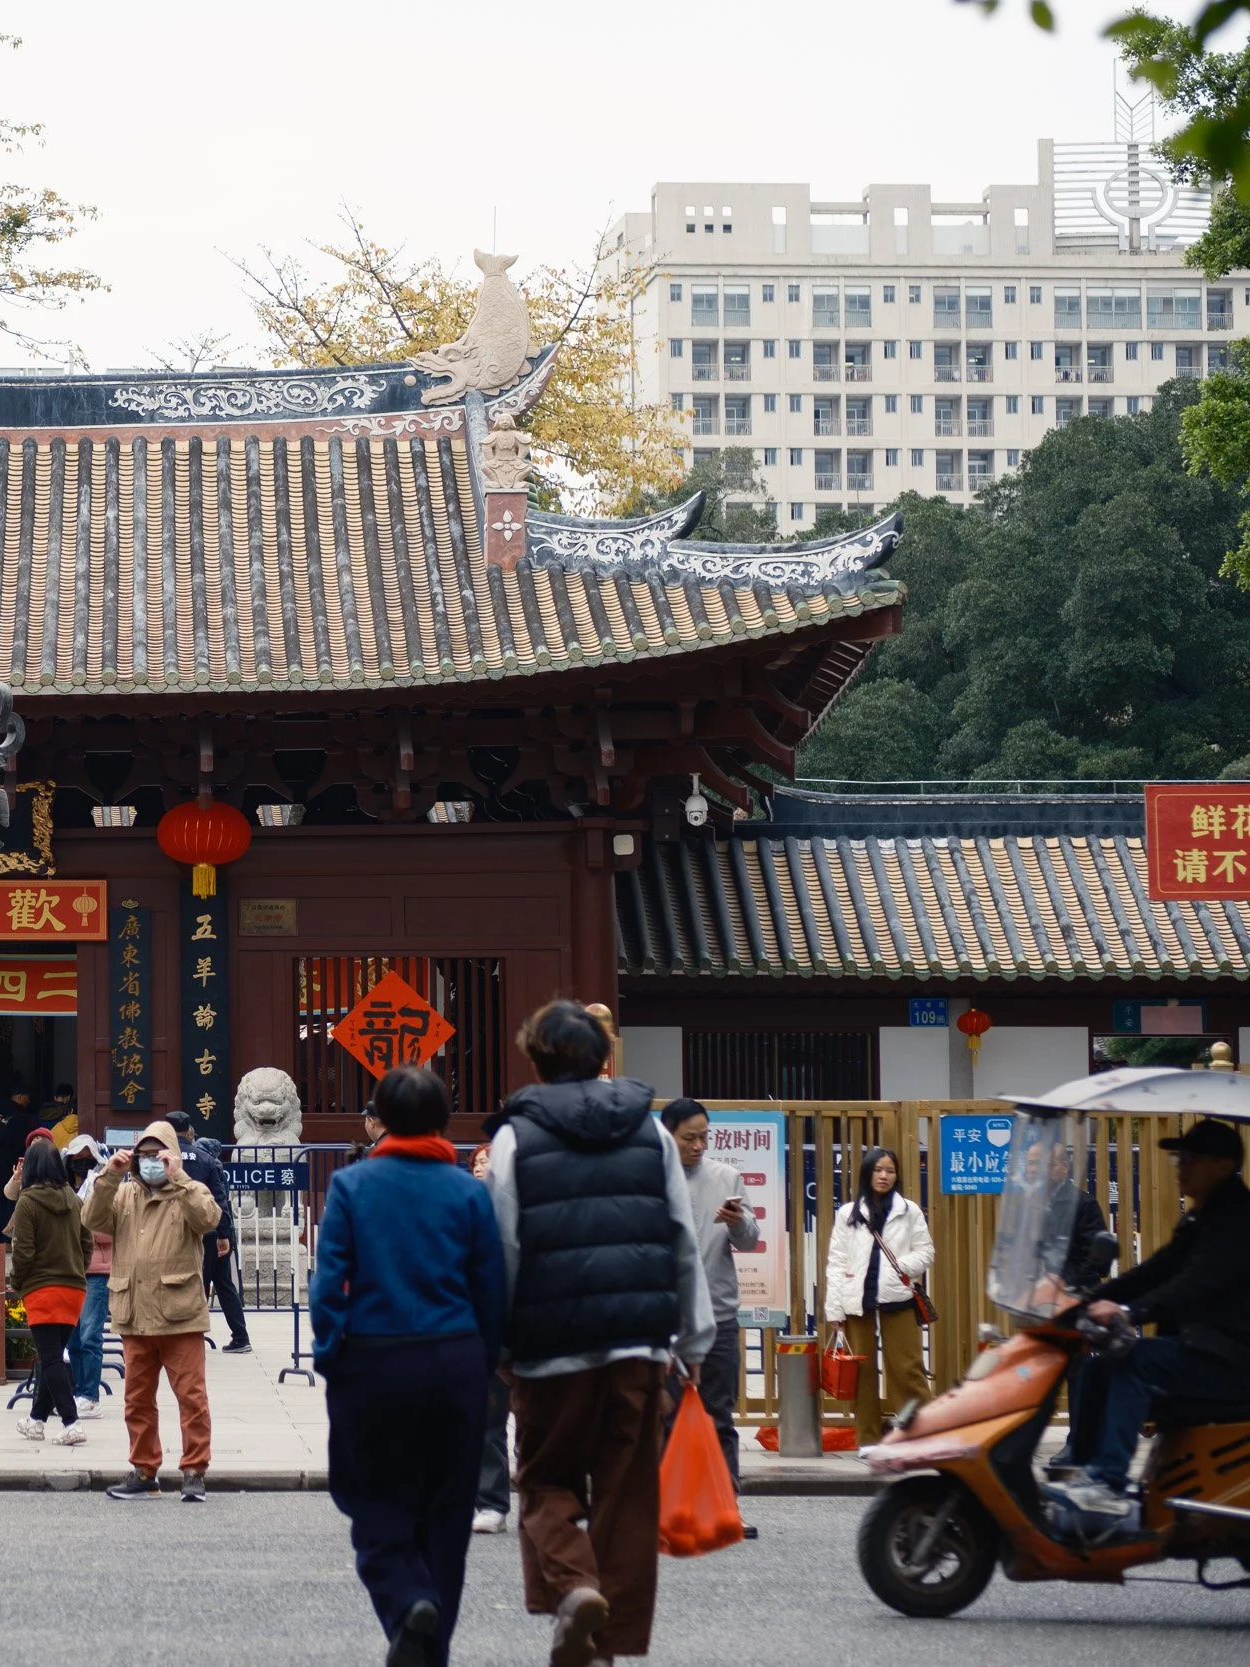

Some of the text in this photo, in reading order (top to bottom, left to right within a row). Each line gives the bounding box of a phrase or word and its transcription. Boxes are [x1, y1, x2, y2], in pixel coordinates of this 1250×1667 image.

[1173, 849, 1247, 883] 请不
[117, 915, 145, 1104] 廣東省佛教協會
[191, 914, 217, 1121] 五羊論古寺
[707, 1129, 771, 1151] 放时间
[953, 1128, 982, 1143] 平安
